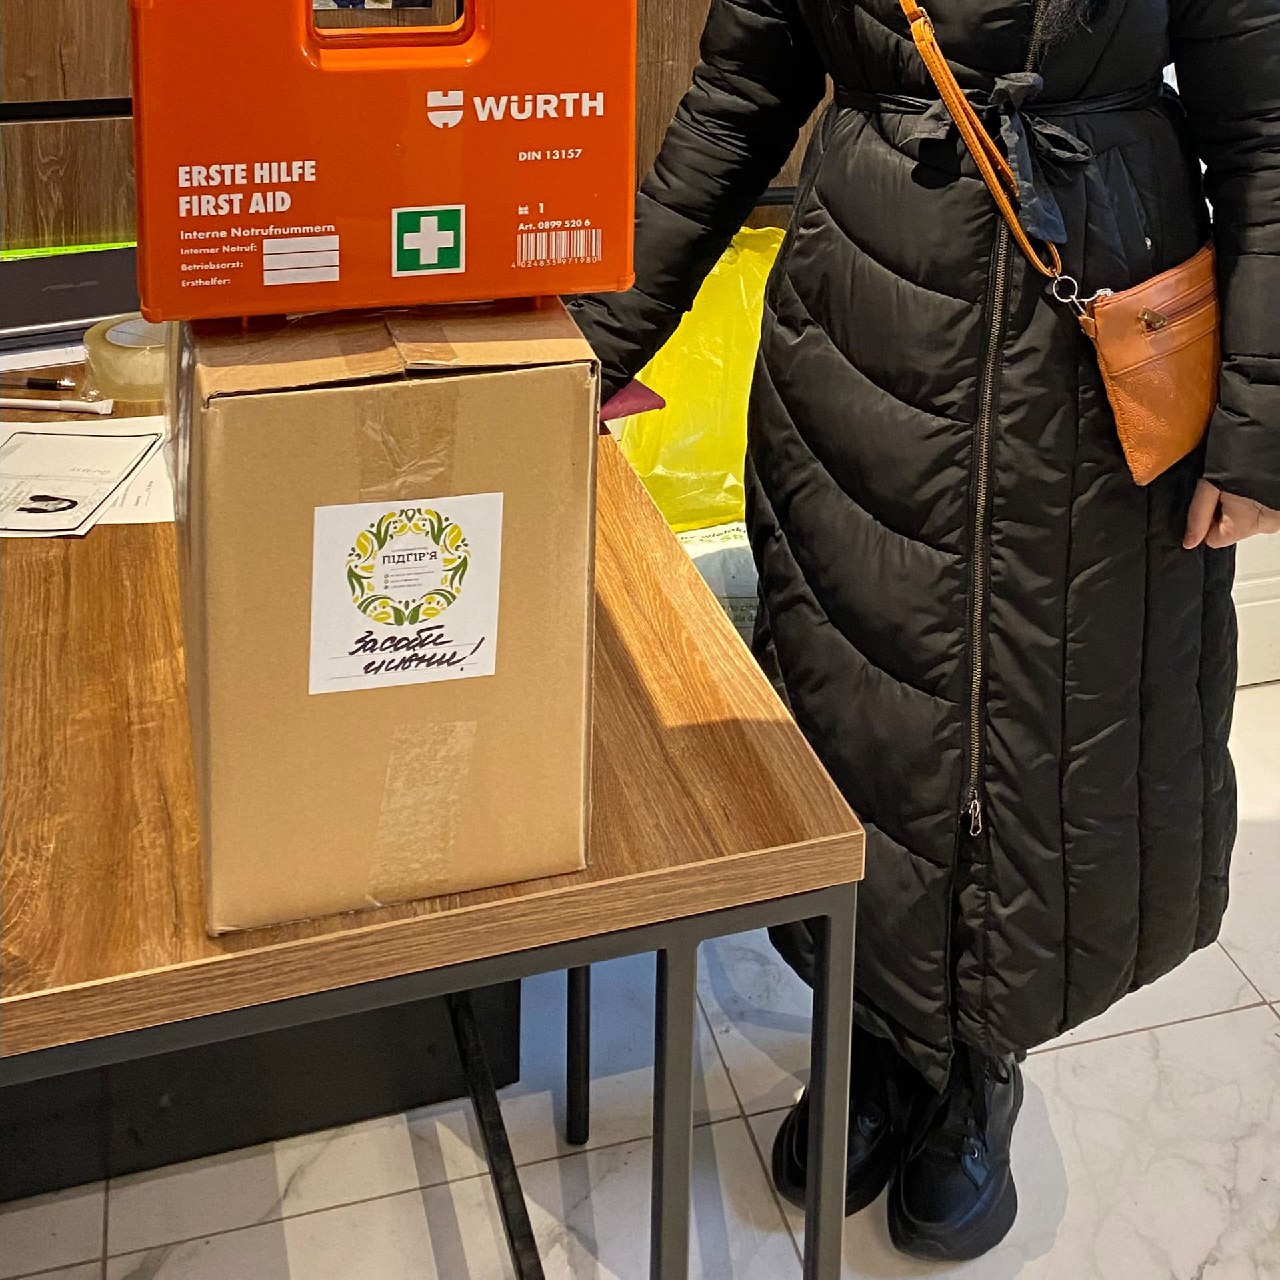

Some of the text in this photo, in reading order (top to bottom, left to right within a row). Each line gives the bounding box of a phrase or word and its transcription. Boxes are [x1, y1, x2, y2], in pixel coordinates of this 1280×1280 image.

[472, 91, 605, 122] WÜRTH
[519, 148, 583, 161] DIN 13157
[178, 160, 317, 188] ERSTE HILFE
[179, 190, 292, 218] FIRST AID
[538, 202, 545, 214] 1
[518, 218, 591, 231] Art. 0899 520 6
[180, 223, 336, 240] Interne Notrufnummern
[180, 242, 258, 255] Interner Notruf:
[181, 261, 244, 271] Betriebsarzt:
[181, 277, 232, 287] Ersthelfer:
[382, 551, 438, 565] ПІДГІР'Я
